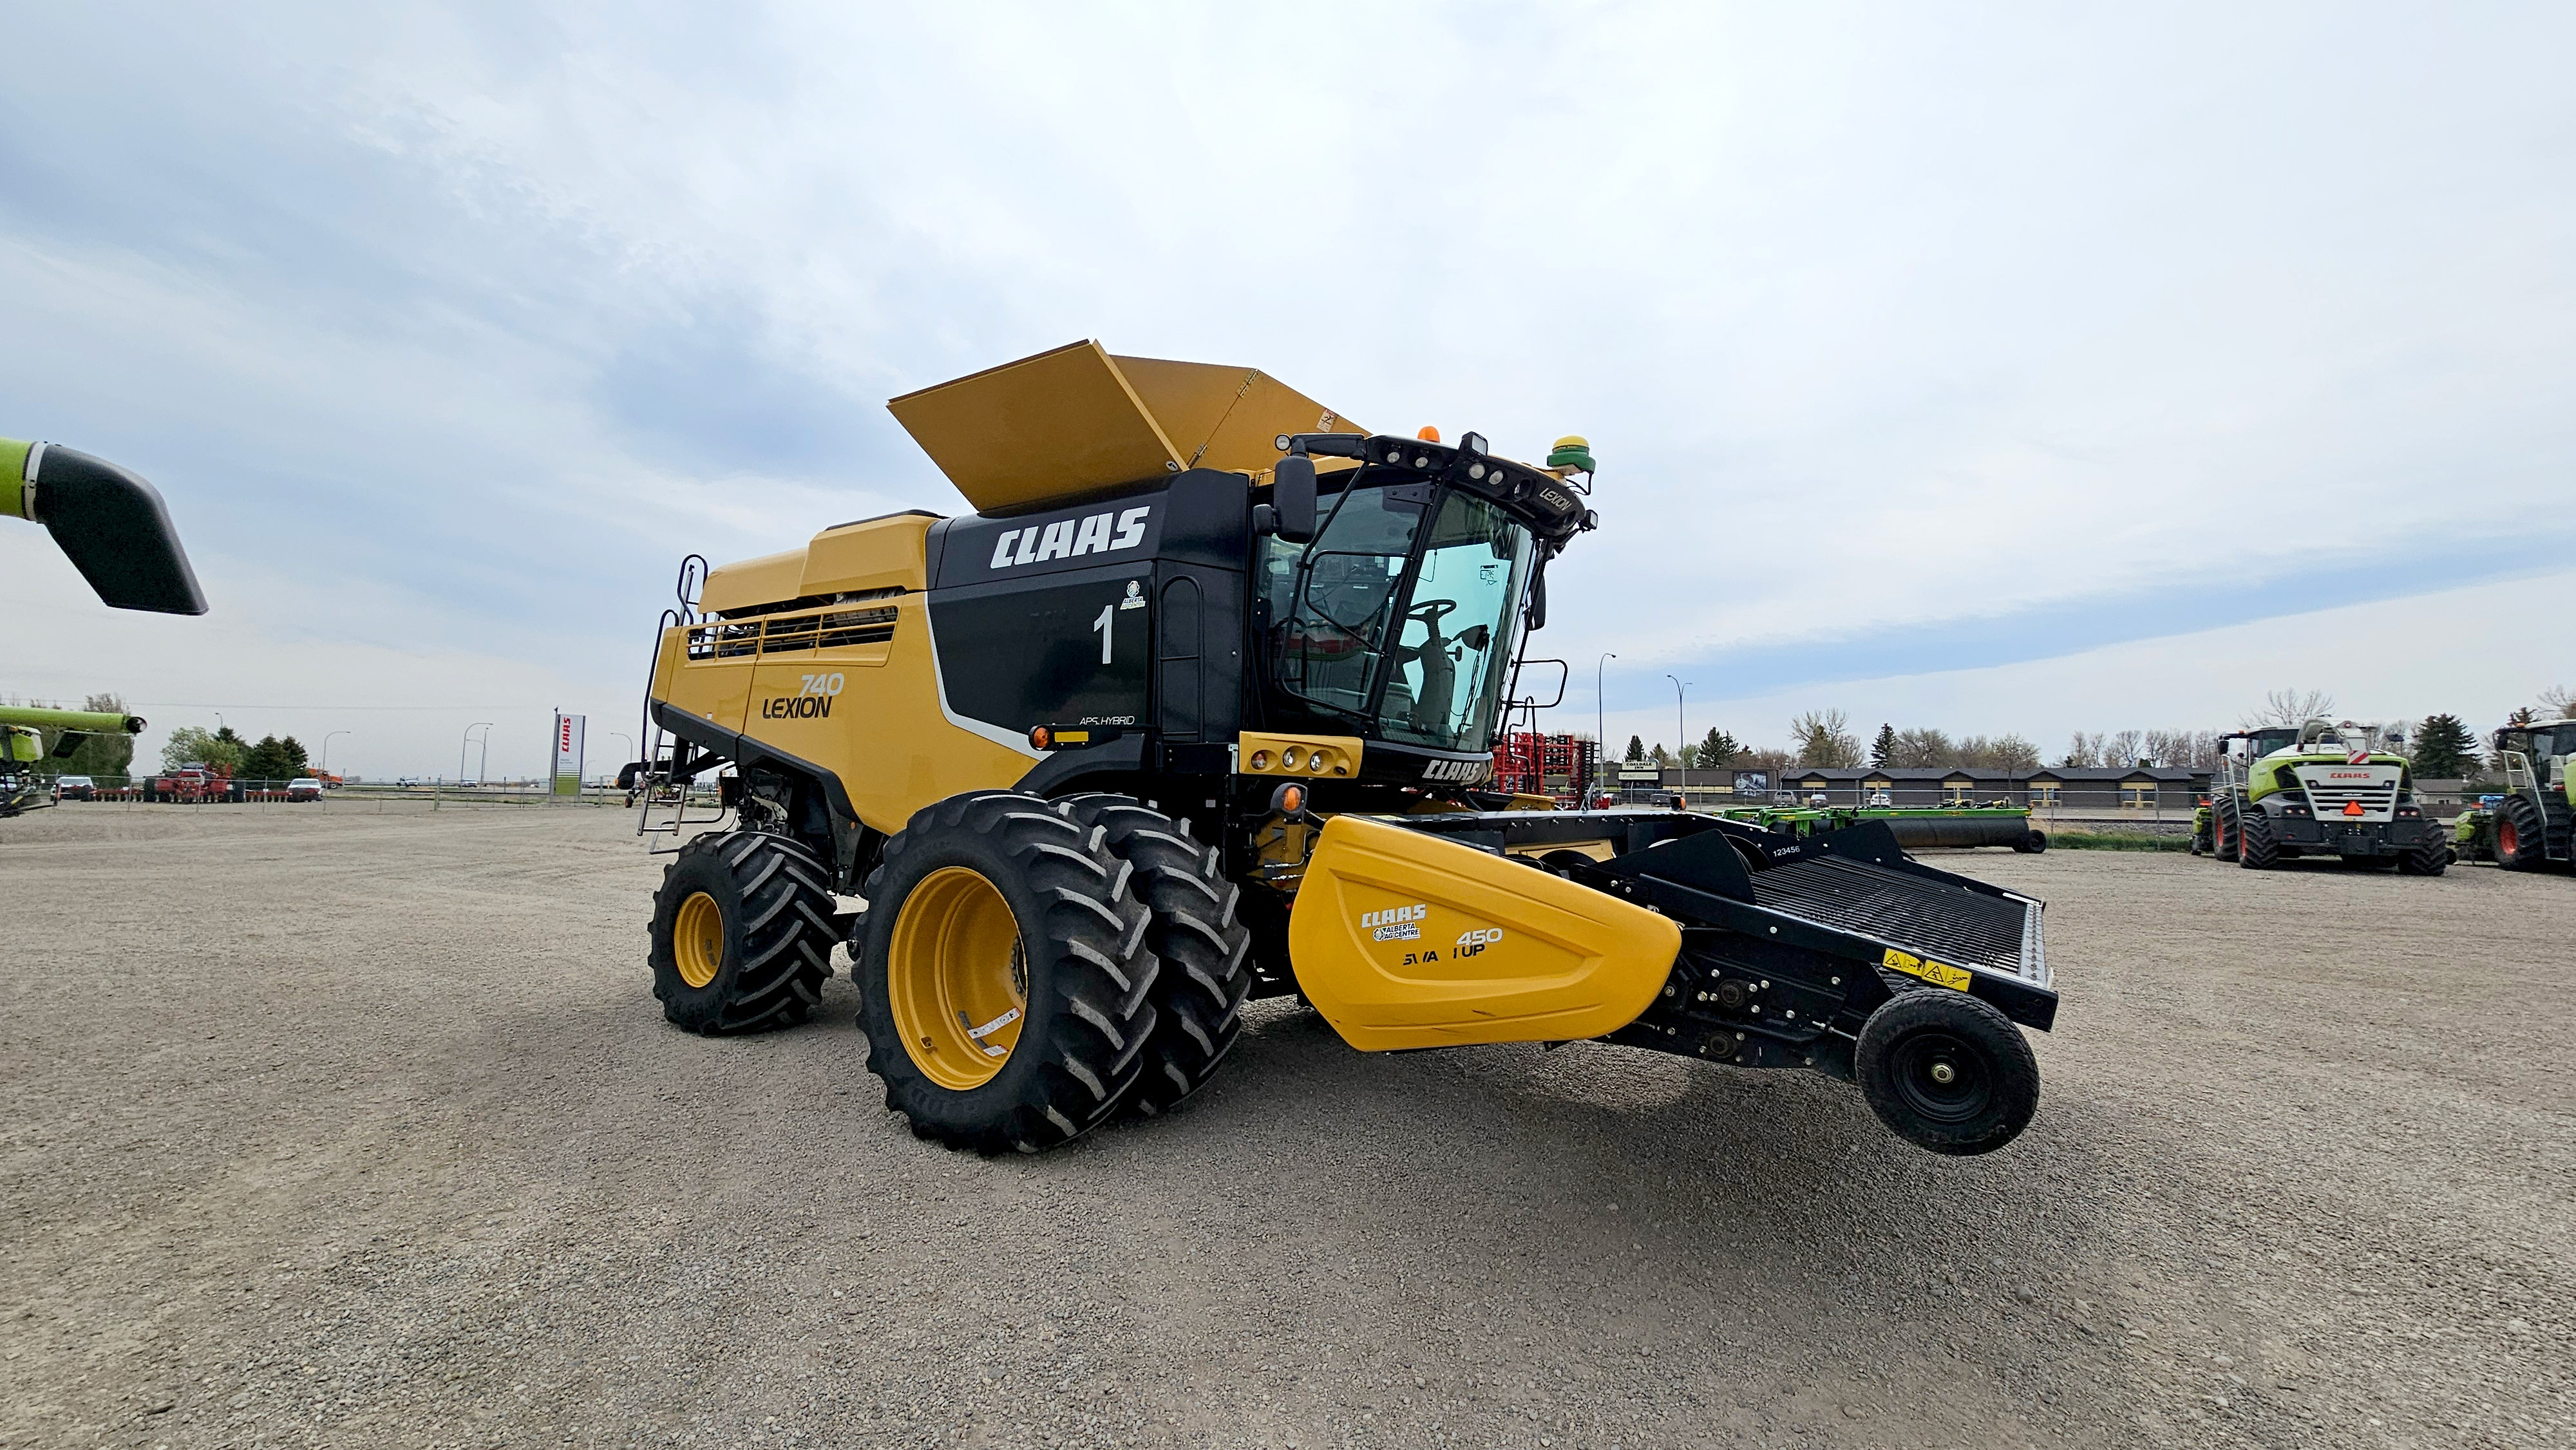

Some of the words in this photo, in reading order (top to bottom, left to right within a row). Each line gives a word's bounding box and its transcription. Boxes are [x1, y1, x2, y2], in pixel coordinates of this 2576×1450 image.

[1539, 487, 1571, 511] LEXION
[990, 505, 1151, 569] CLAAS
[1094, 605, 1113, 664] 1
[799, 672, 845, 697] 740
[762, 696, 832, 719] LEXION
[1101, 715, 1135, 725] HYBRID
[562, 717, 571, 752] CLAAS
[1422, 760, 1481, 780] CLAAS
[1773, 845, 1800, 857] 123456
[1361, 904, 1426, 928] CLAAS
[1387, 923, 1415, 933] ALBERTA
[1456, 928, 1503, 946] 450
